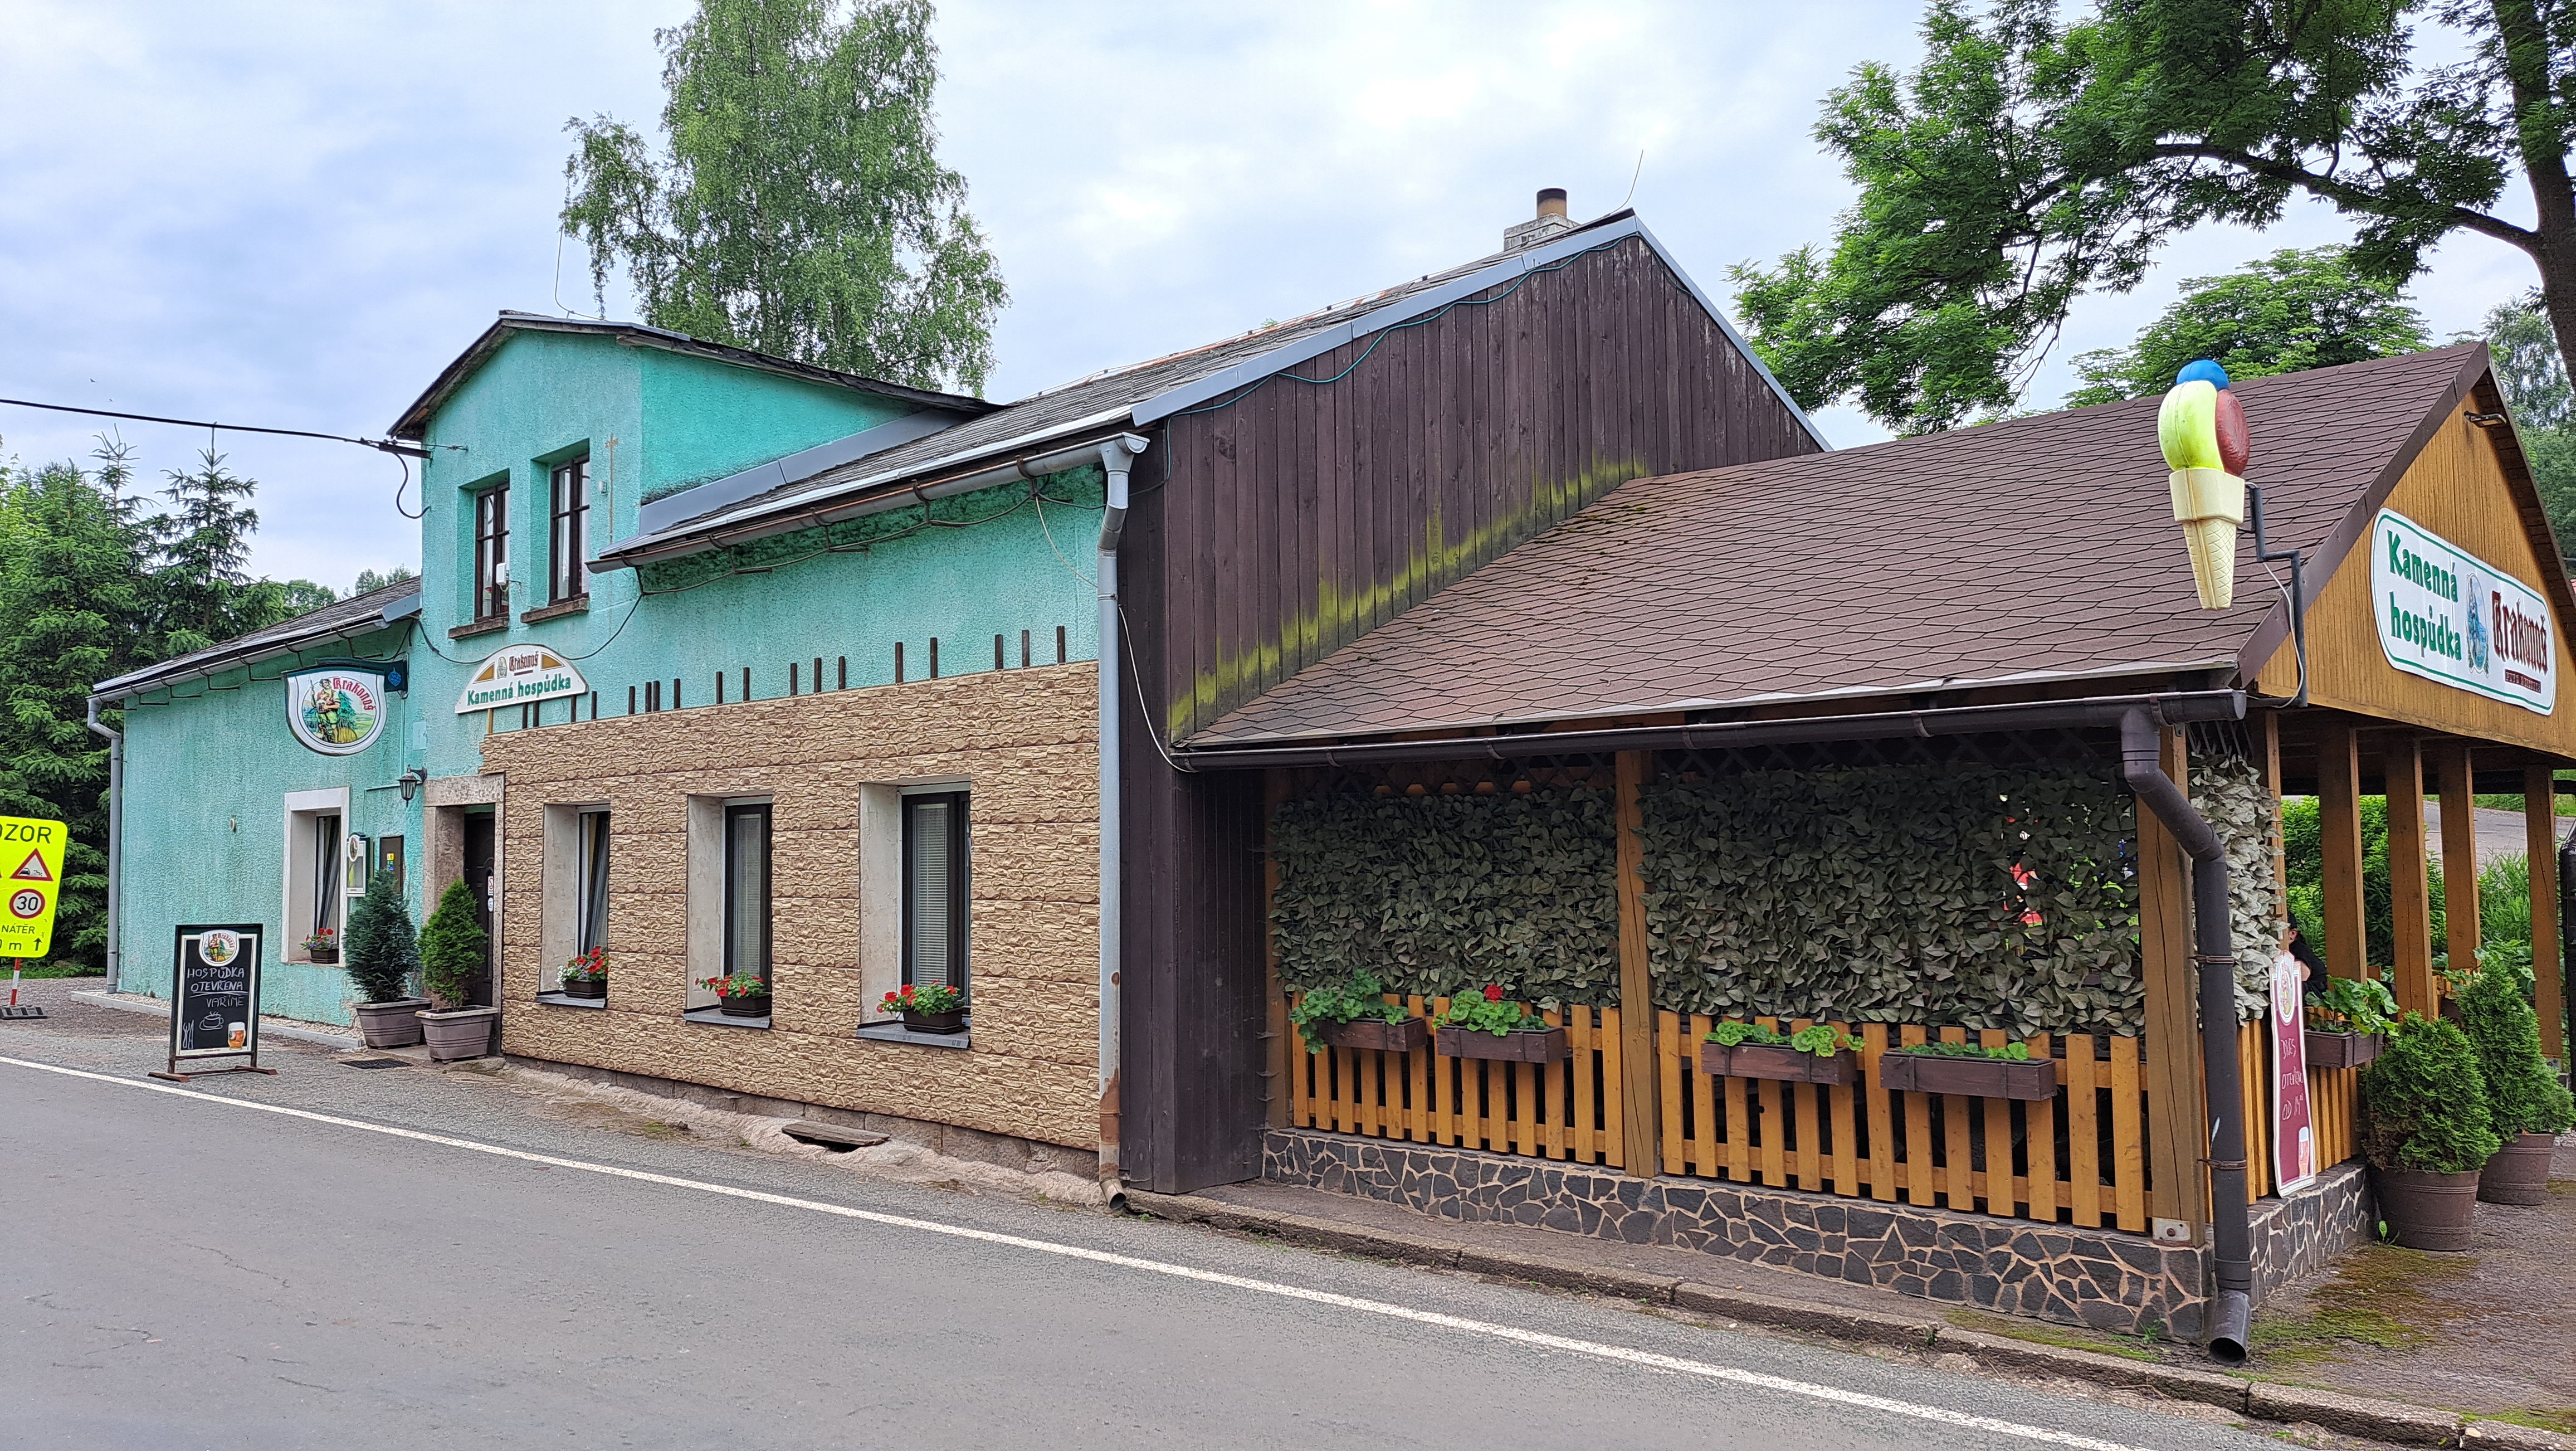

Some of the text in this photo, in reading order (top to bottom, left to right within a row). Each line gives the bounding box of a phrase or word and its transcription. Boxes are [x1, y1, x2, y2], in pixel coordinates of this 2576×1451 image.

[2387, 529, 2458, 603] Kamenná
[2389, 591, 2462, 661] hospůdka
[2492, 590, 2548, 675] Krakonoš
[509, 651, 539, 671] Krakonoš
[333, 678, 377, 710] Krakonoš
[467, 673, 571, 706] Kamenná hospůdka
[0, 823, 52, 844] ZOR
[16, 895, 38, 911] 30
[1, 923, 35, 934] NÁTĚR
[191, 980, 243, 992] OTEVŘENA
[2282, 1099, 2292, 1121] OD
